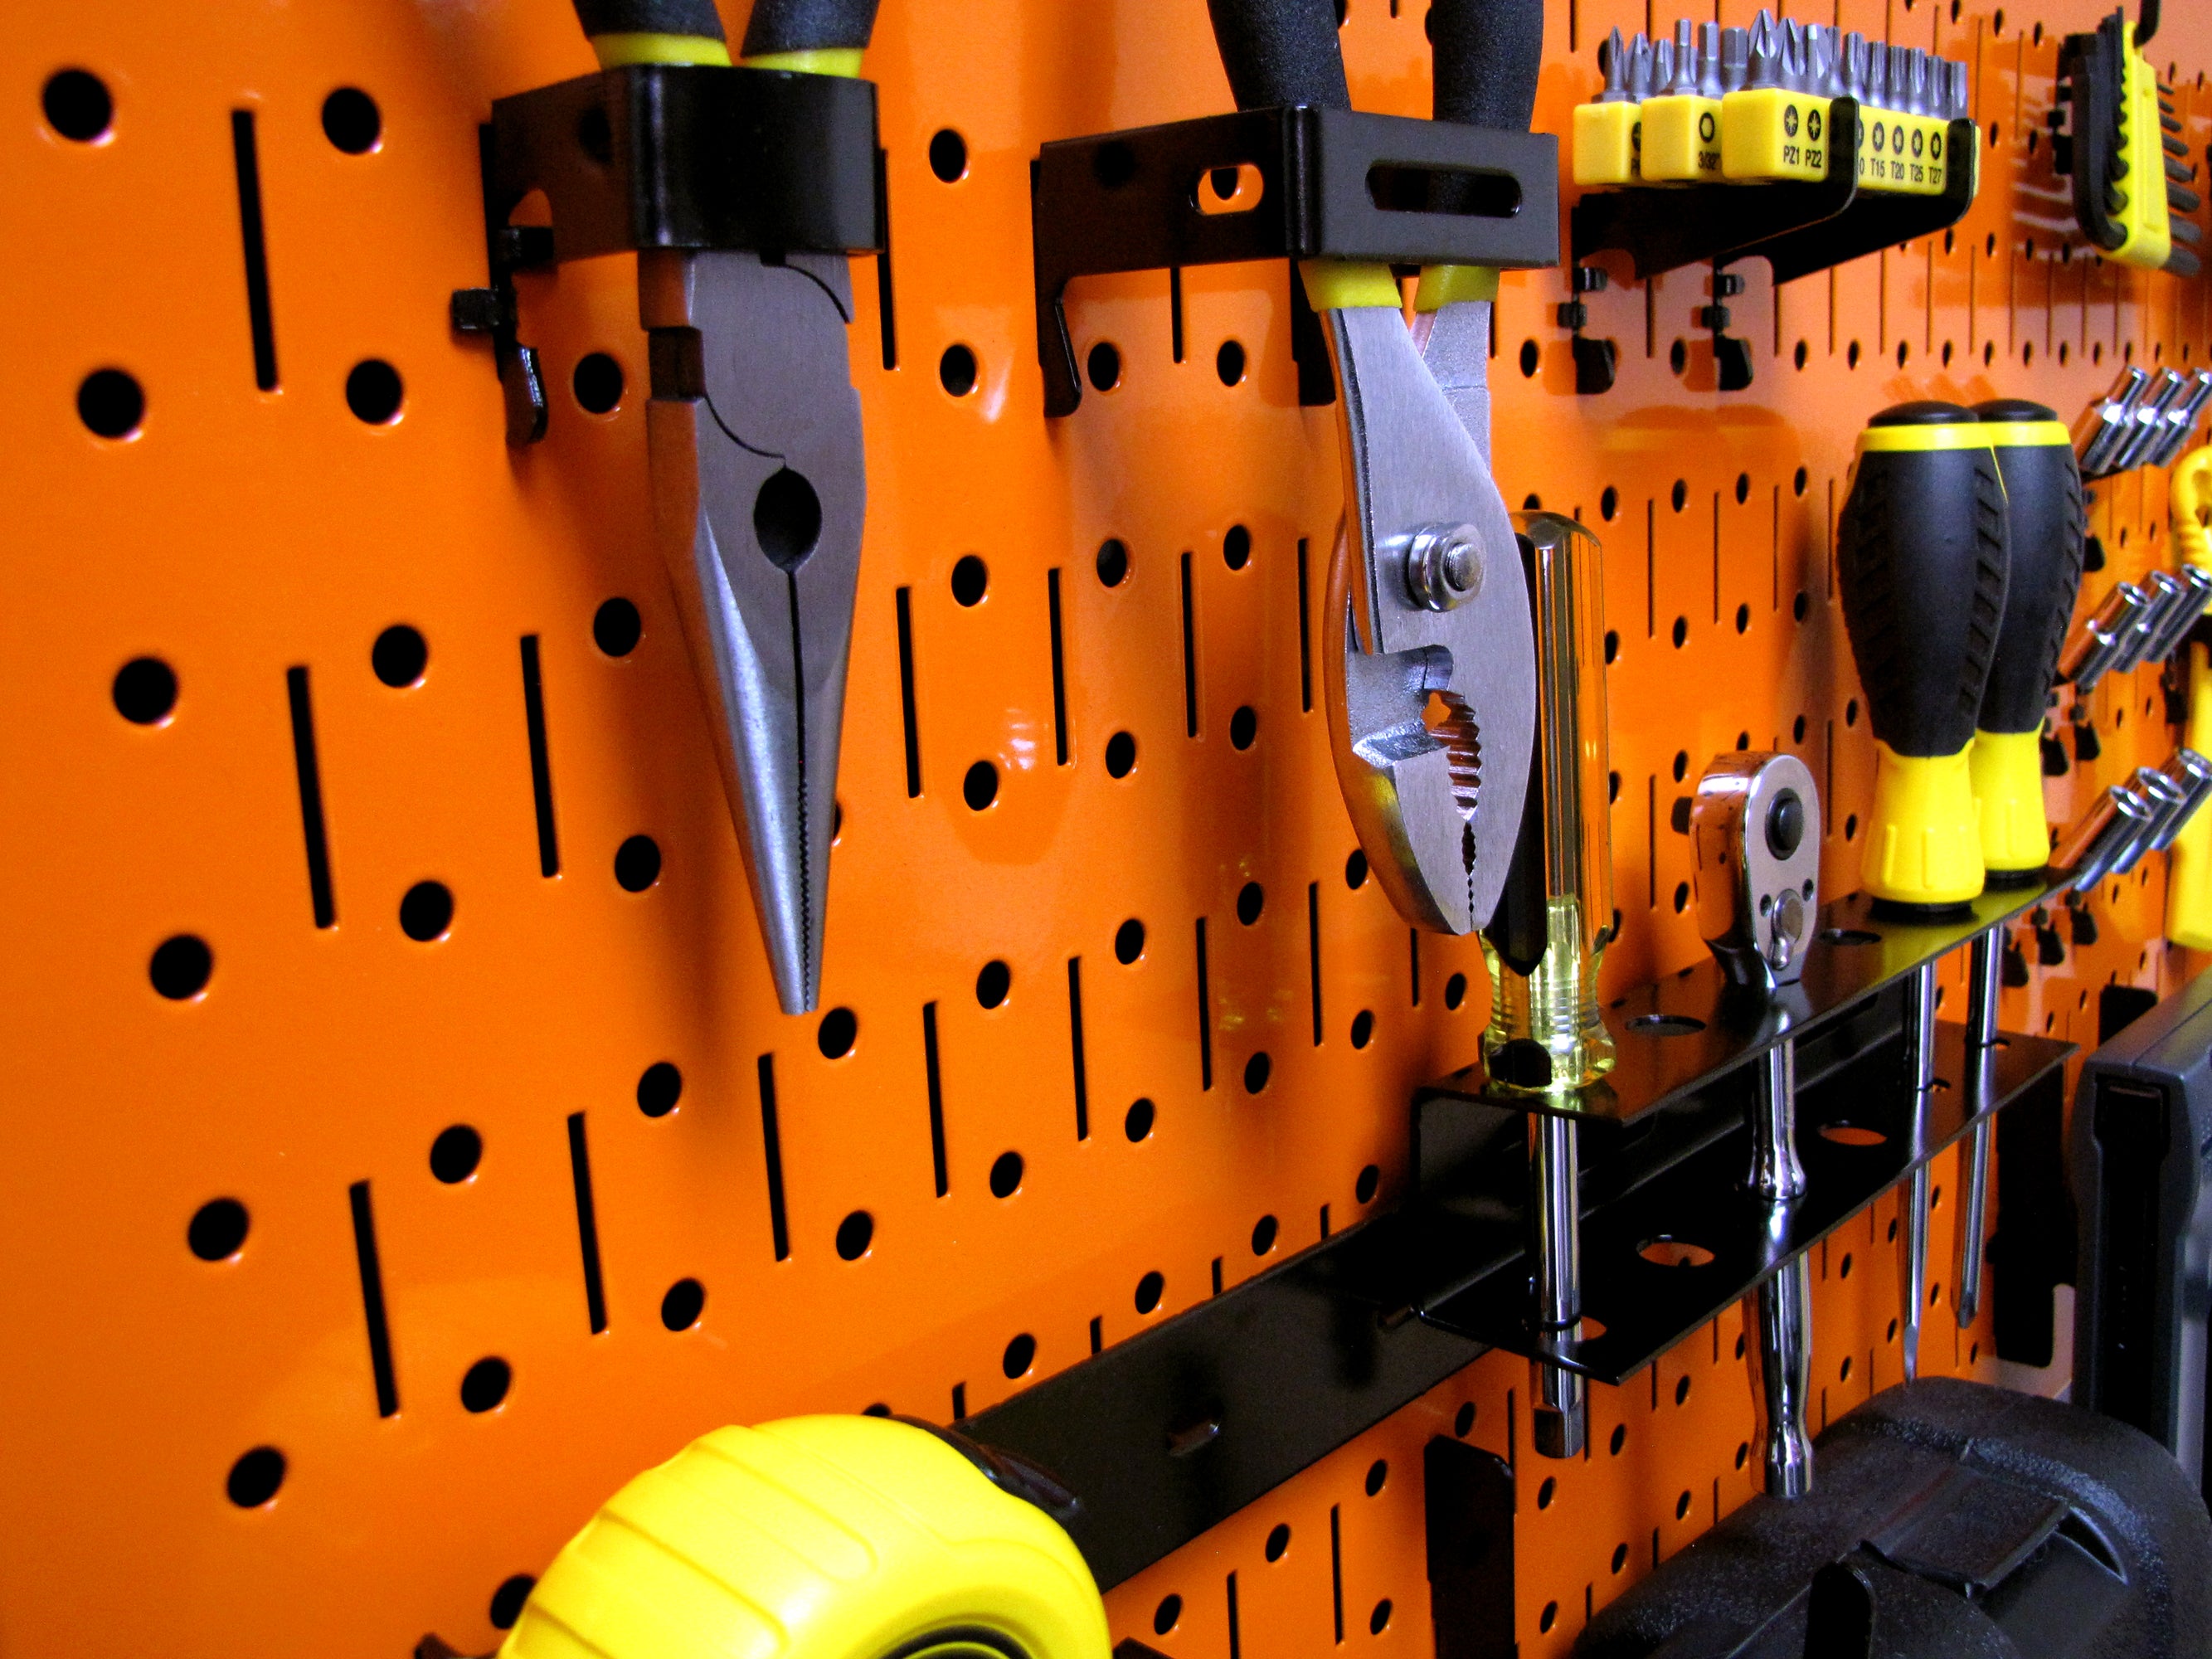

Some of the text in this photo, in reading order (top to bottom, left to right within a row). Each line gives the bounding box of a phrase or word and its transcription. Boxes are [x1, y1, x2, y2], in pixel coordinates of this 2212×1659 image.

[1783, 144, 1800, 165] PZ1
[1805, 148, 1822, 168] PZ2
[1870, 158, 1885, 178] T15
[1890, 160, 1904, 180] T20
[1909, 163, 1923, 182] T25
[1929, 166, 1942, 184] T27
